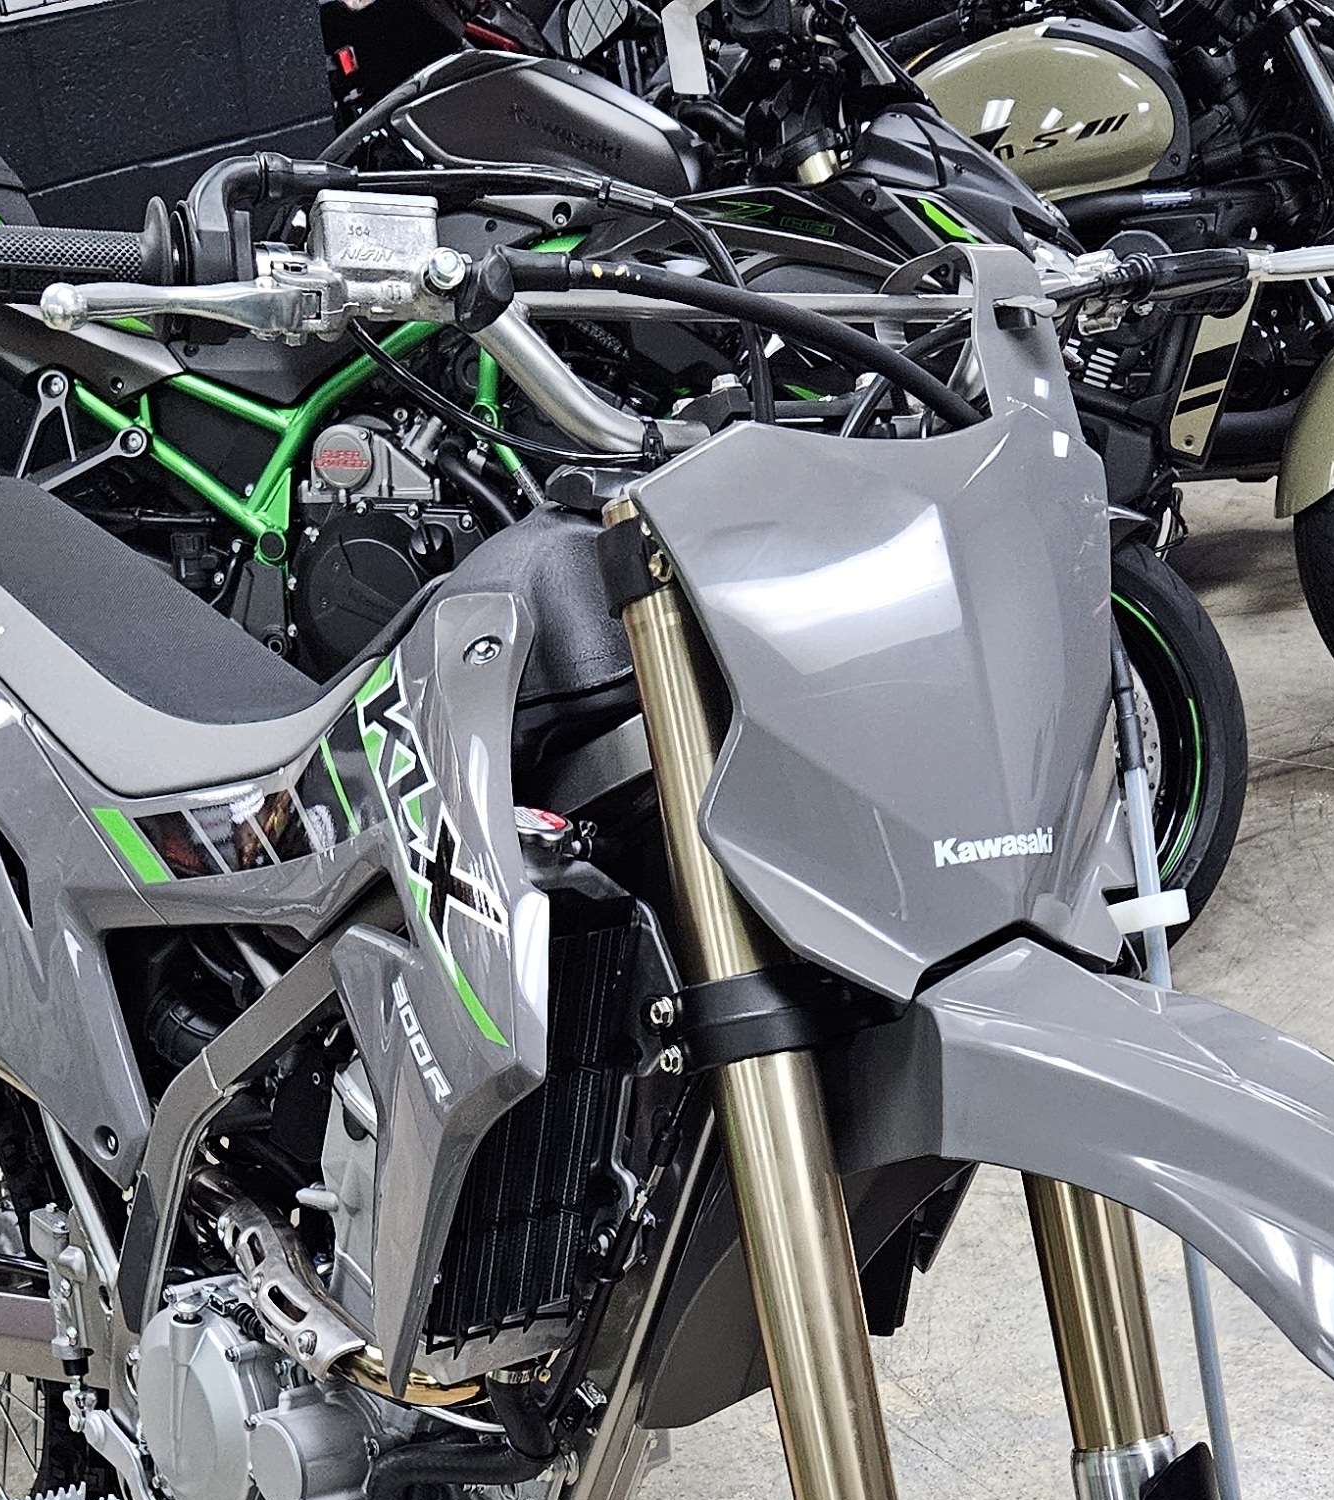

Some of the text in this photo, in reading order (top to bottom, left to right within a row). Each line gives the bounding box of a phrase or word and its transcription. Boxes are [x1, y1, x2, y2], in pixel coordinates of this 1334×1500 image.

[356, 645, 511, 987] KLX
[933, 826, 1054, 868] Kawasaki
[391, 971, 453, 1104] 300R
